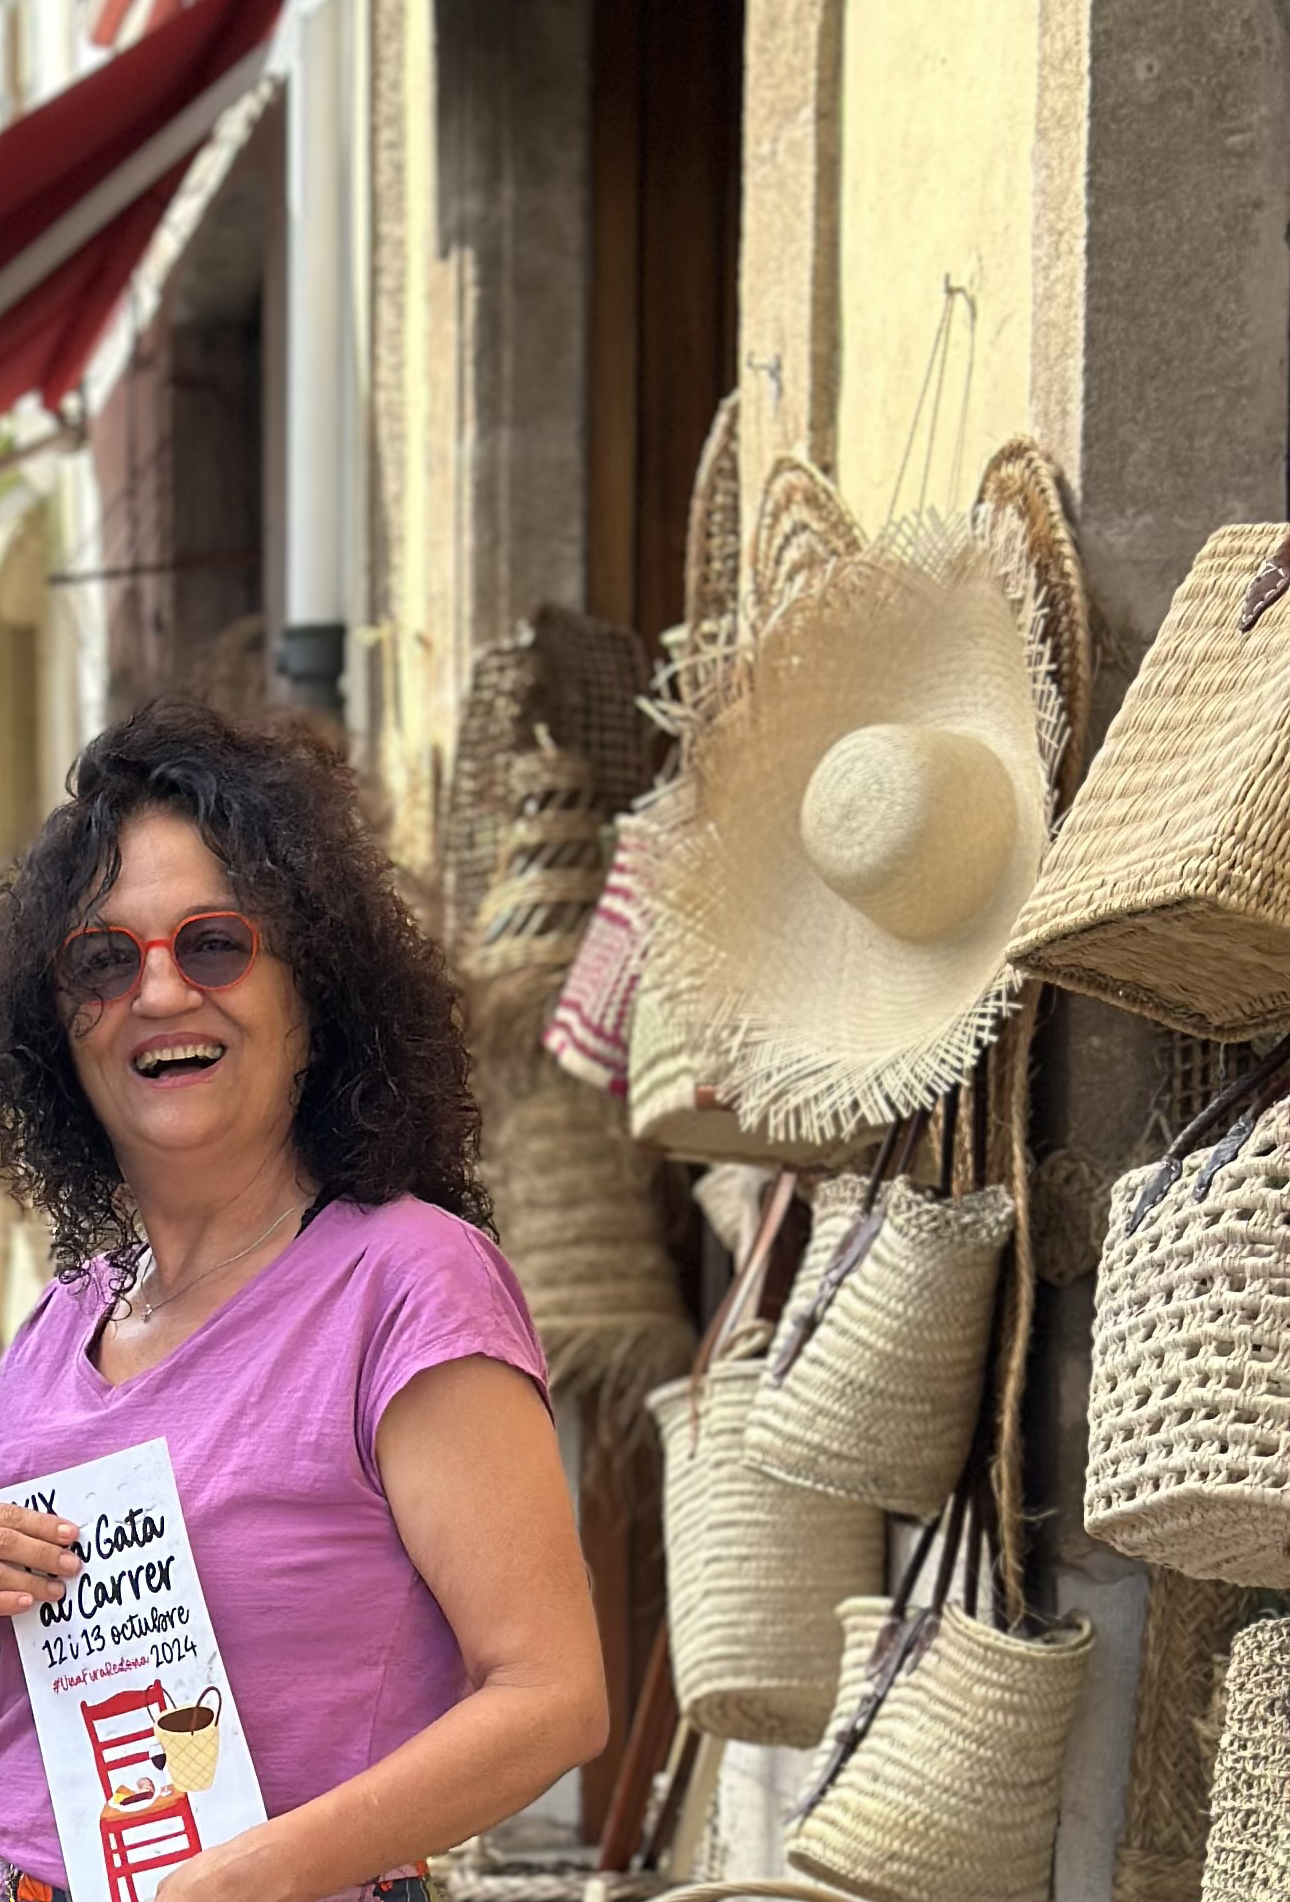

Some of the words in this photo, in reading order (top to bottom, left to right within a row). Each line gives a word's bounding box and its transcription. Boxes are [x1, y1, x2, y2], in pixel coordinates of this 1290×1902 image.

[96, 1508, 164, 1559] Gata
[78, 1556, 174, 1619] Carrer
[42, 1637, 68, 1668] 12
[68, 1634, 79, 1659] i
[81, 1625, 106, 1656] 13
[111, 1605, 190, 1645] octubre
[150, 1635, 197, 1668] 2024
